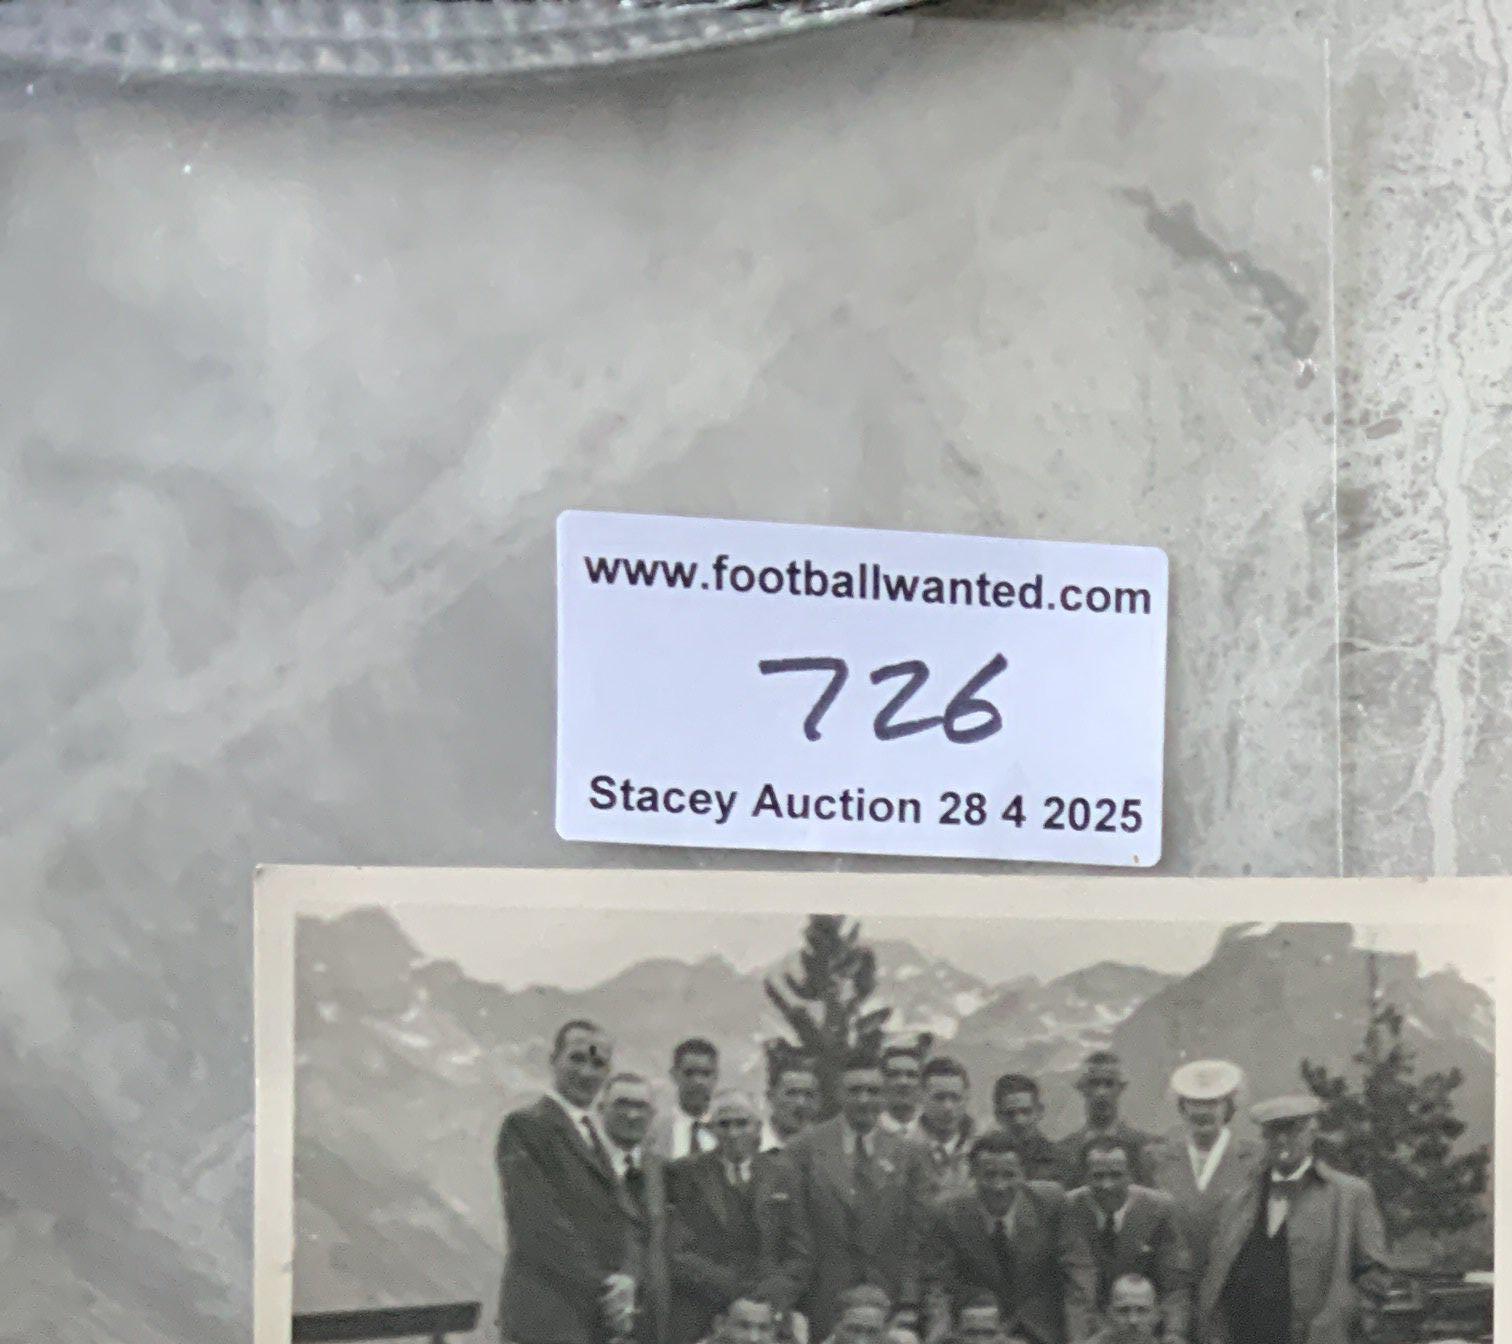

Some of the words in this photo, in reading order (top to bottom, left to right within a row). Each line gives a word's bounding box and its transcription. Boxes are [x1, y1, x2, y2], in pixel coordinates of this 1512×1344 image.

[584, 554, 1151, 614] www.footballwanted.com
[758, 653, 1008, 744] 726
[589, 775, 738, 825] Stacey
[752, 783, 921, 824] Auction
[938, 791, 987, 826] 28
[1001, 794, 1027, 828] 4
[1042, 796, 1142, 833] 2025
